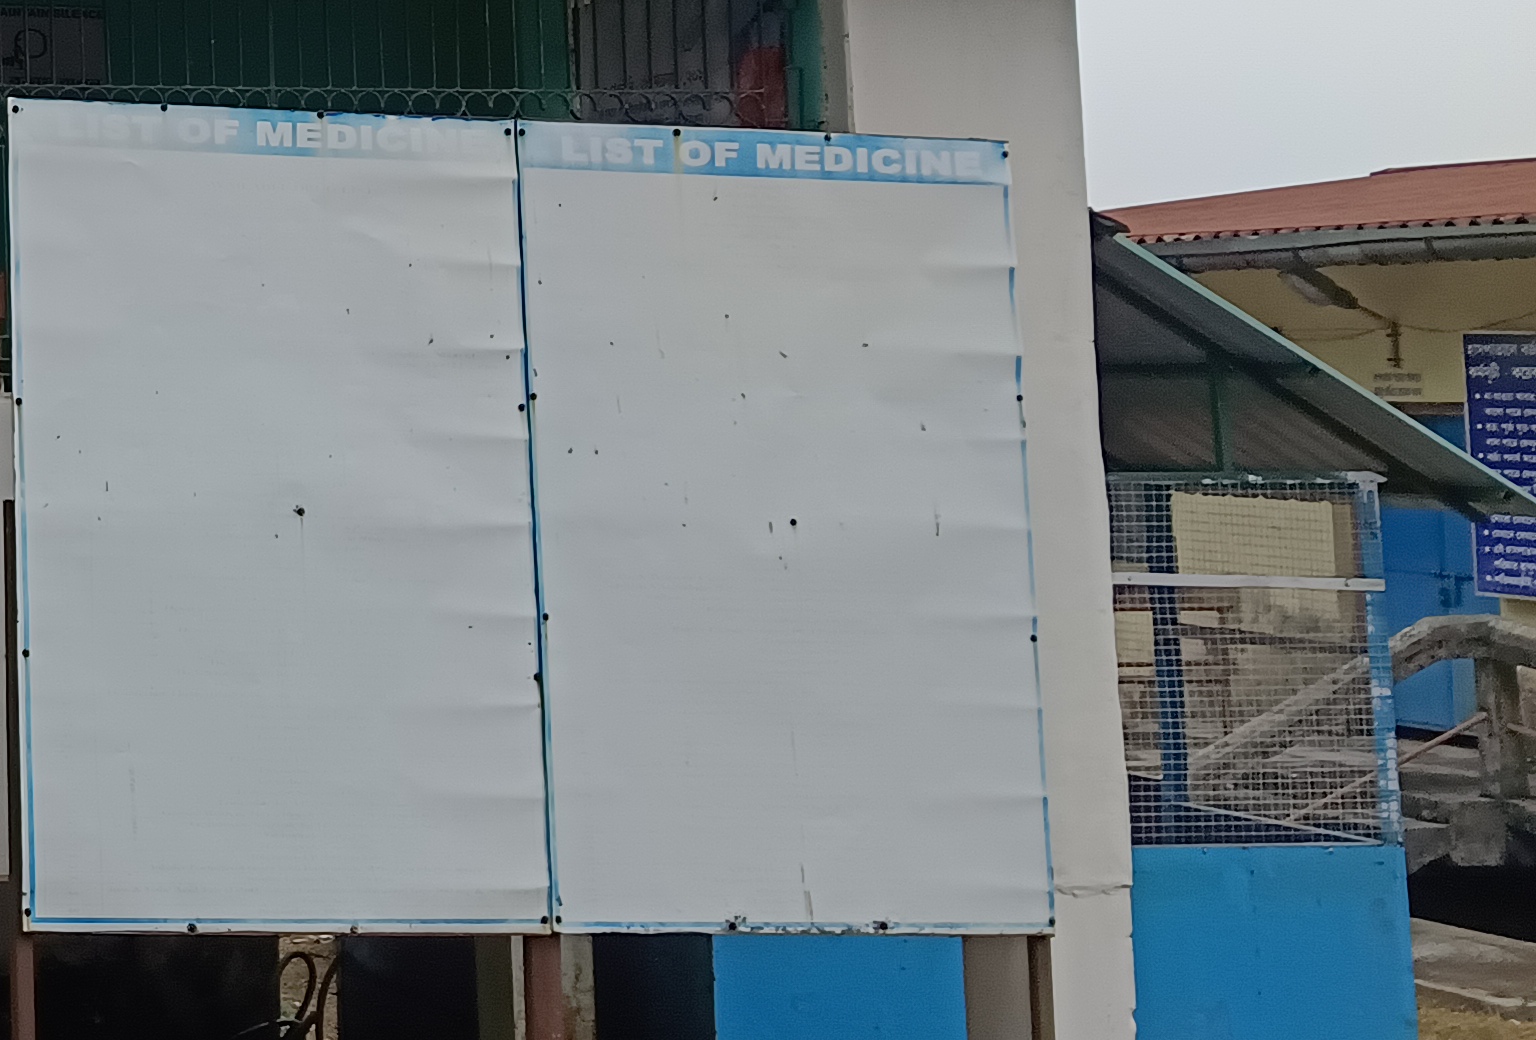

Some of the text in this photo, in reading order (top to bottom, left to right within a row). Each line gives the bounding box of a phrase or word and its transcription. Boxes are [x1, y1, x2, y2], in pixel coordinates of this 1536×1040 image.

[56, 110, 490, 155] LIST OF MEDICINE
[560, 134, 983, 178] LIST OF MEDICINE
